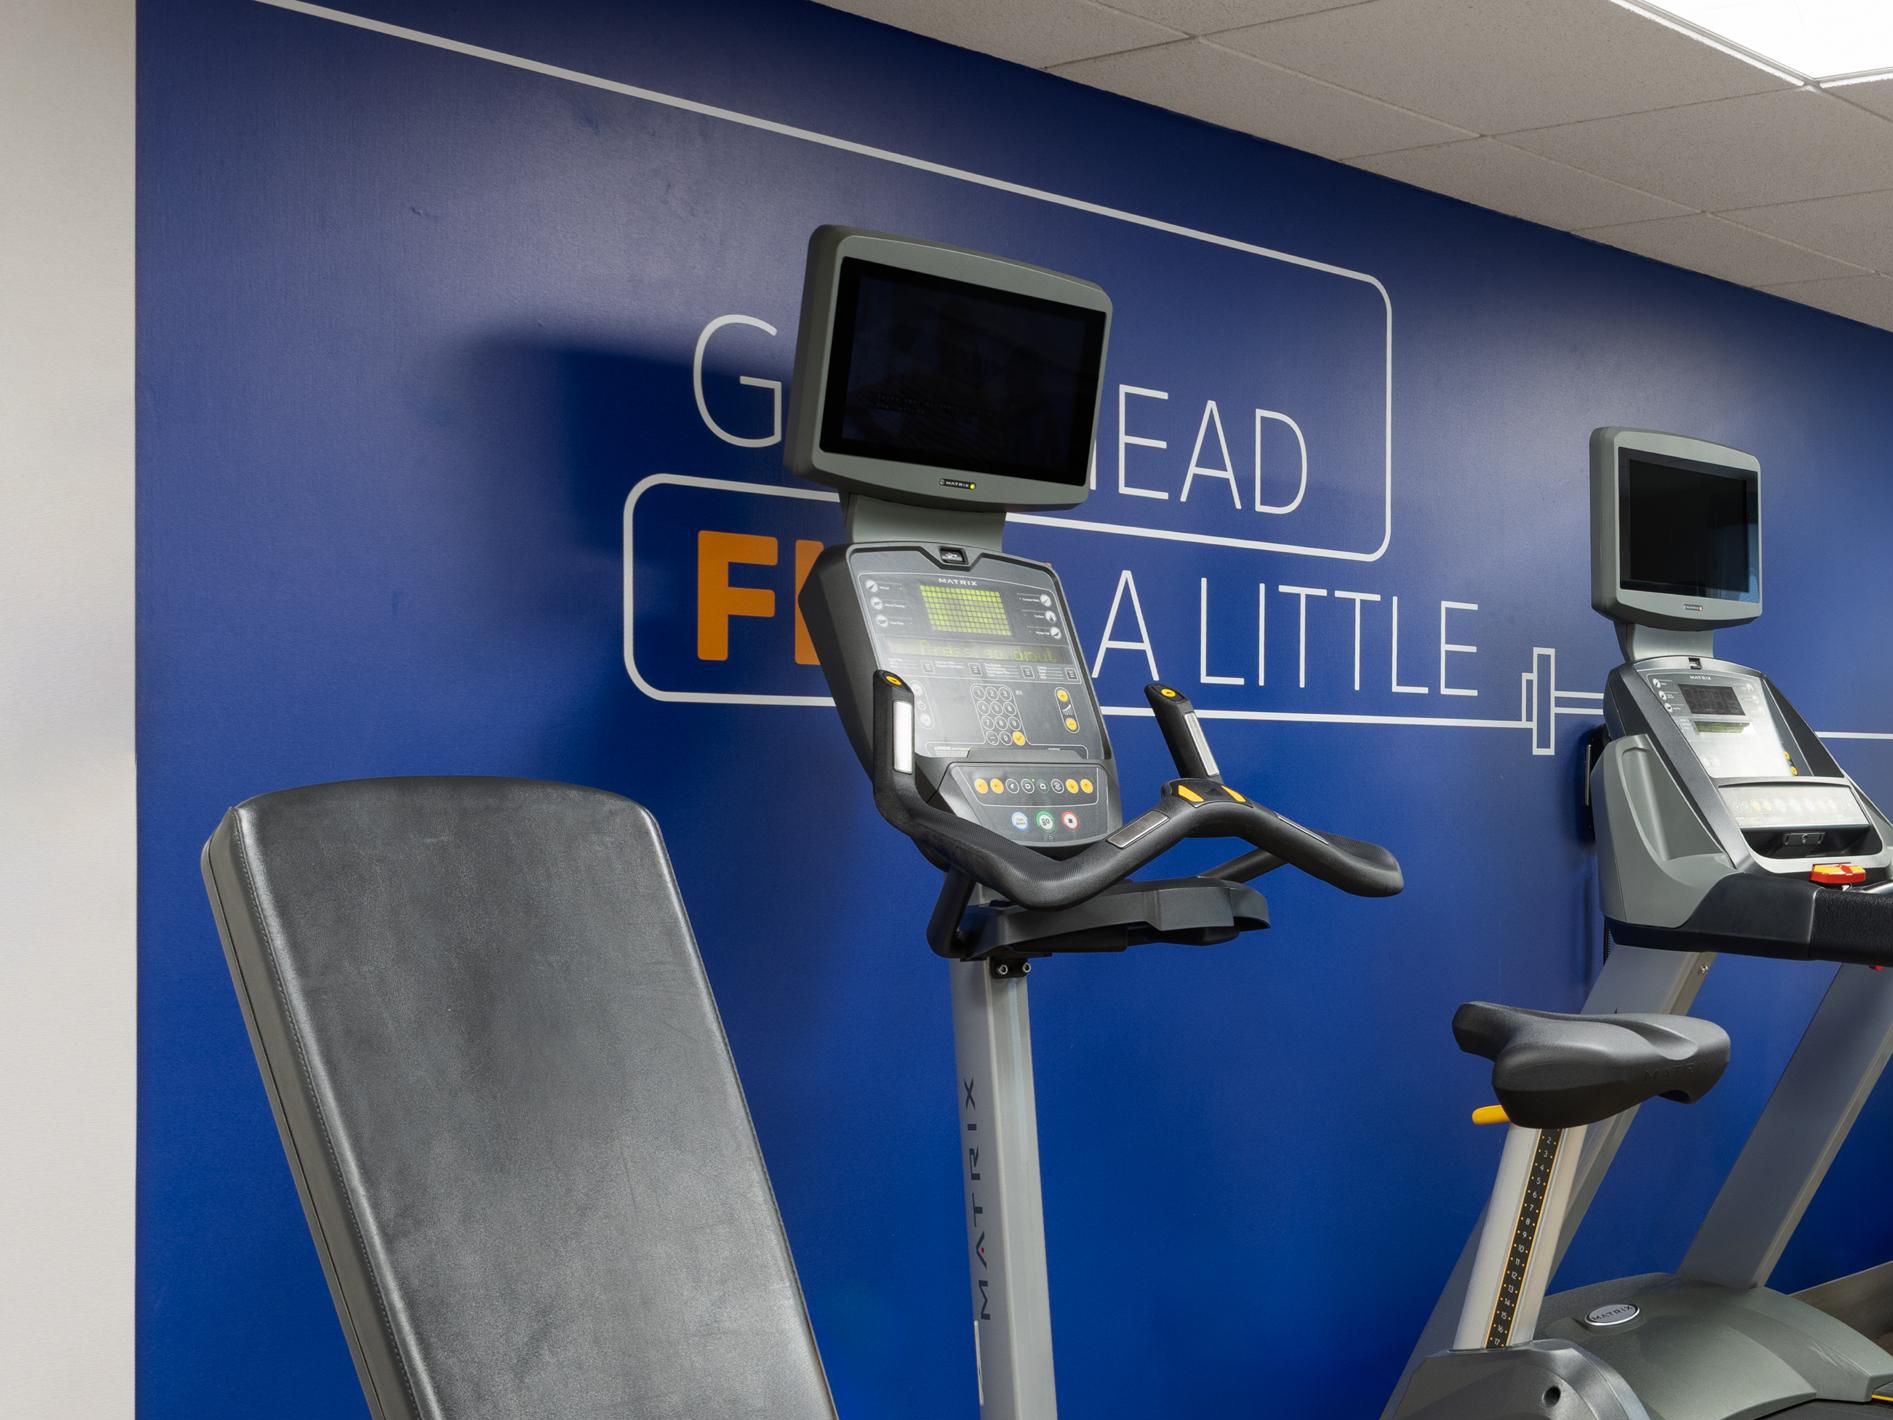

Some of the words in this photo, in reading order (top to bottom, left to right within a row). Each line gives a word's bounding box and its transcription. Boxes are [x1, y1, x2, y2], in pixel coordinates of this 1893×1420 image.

[938, 577, 978, 586] MATRIX
[1091, 569, 1160, 682] A
[1199, 577, 1479, 696] LITTLE
[963, 1077, 992, 1321] MATRIX
[1591, 1305, 1634, 1321] MATRIX
